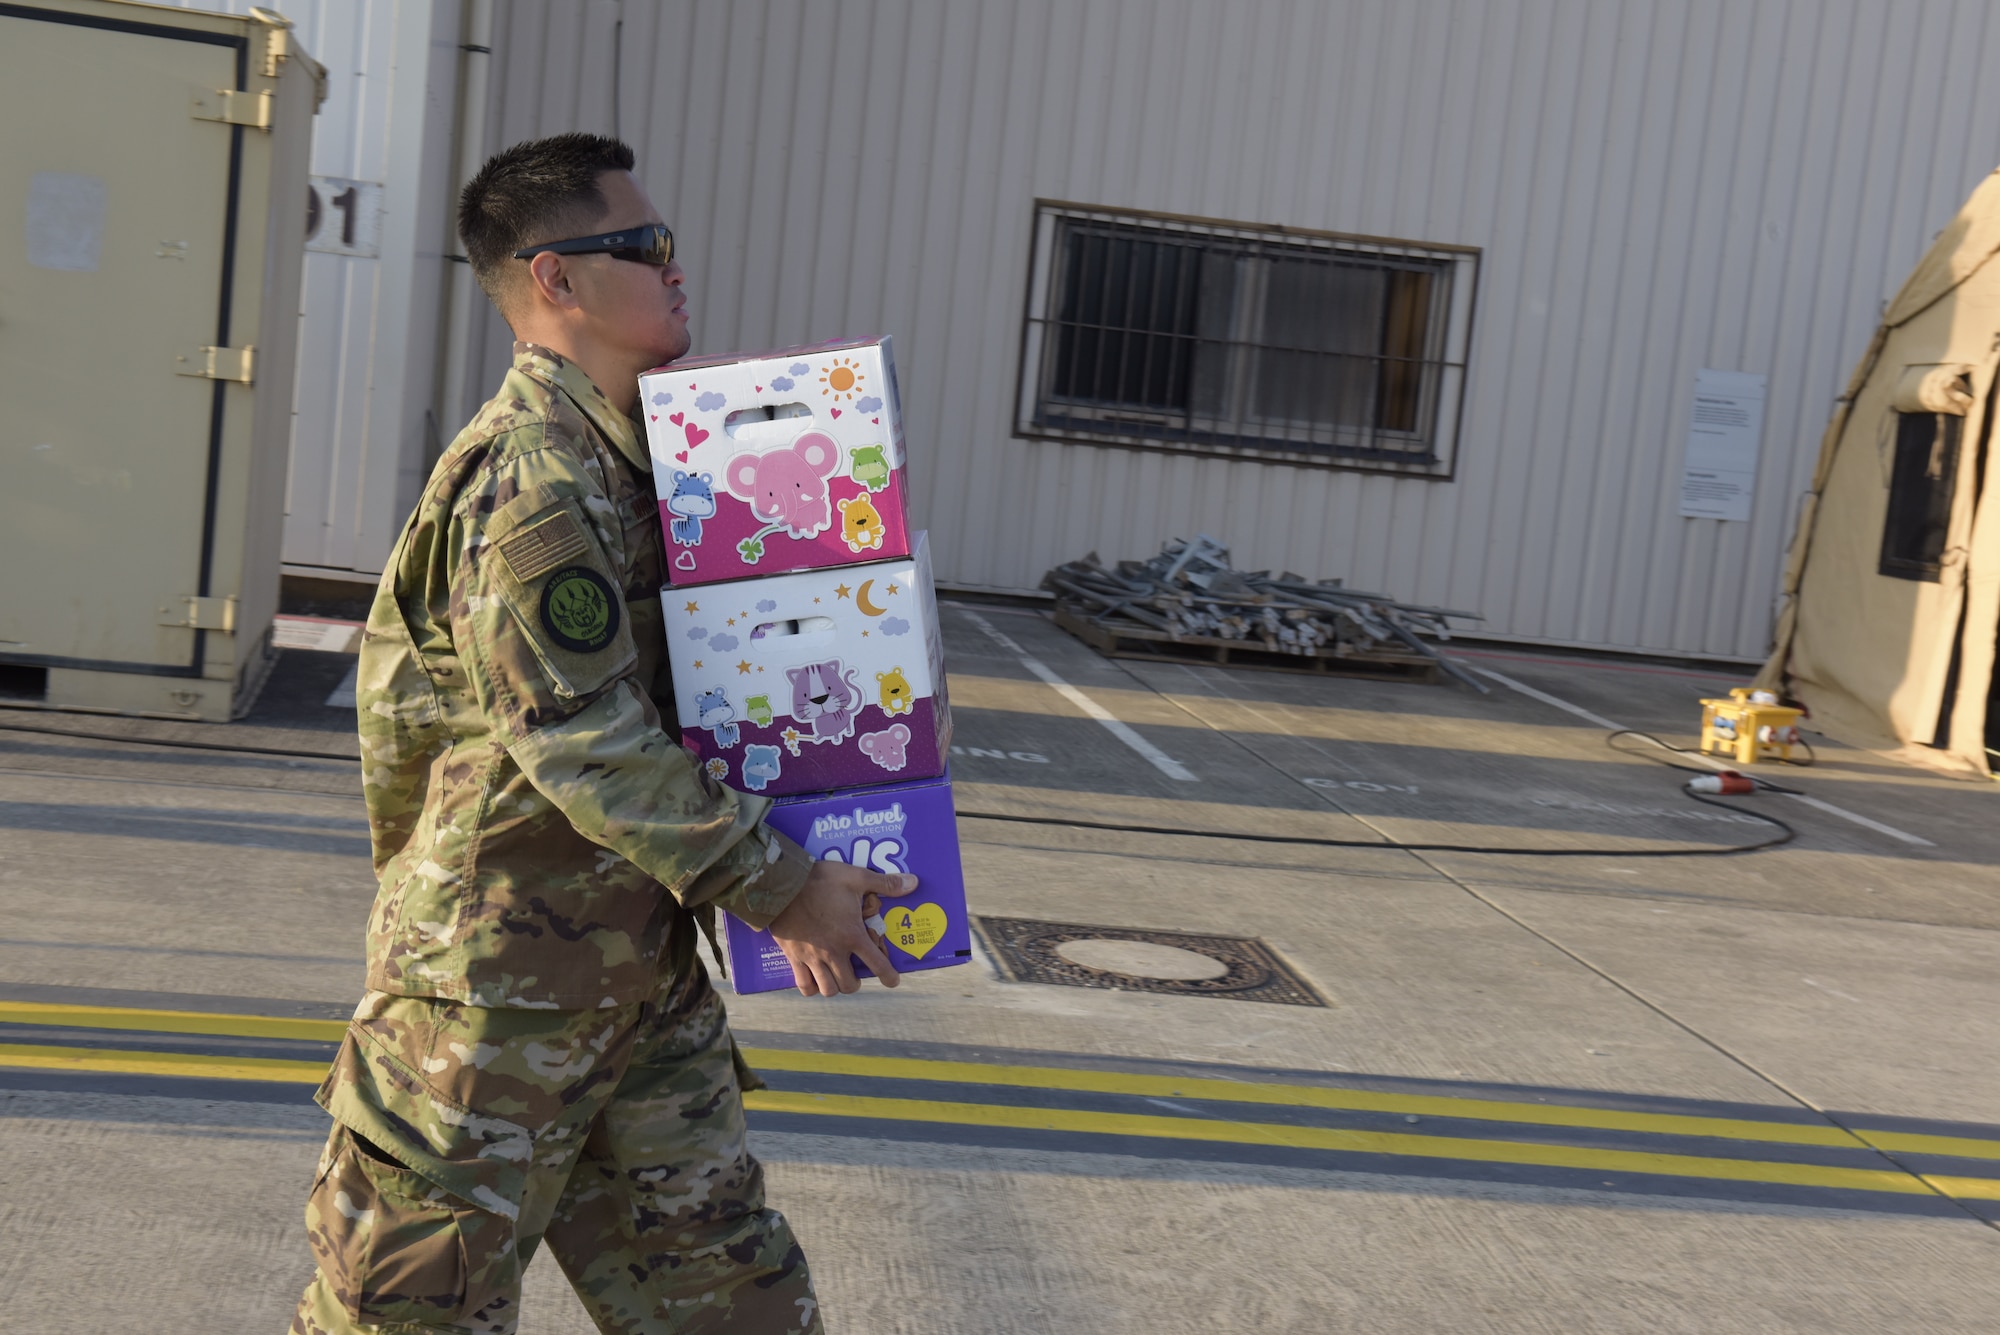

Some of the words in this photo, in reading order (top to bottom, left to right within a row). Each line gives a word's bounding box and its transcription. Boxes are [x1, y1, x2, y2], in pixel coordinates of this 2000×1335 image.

[815, 815, 851, 839] pro
[855, 804, 904, 827] level
[823, 832, 845, 840] LEAK
[847, 824, 902, 837] PROTECTION
[901, 914, 912, 929] 4
[901, 934, 915, 945] 88
